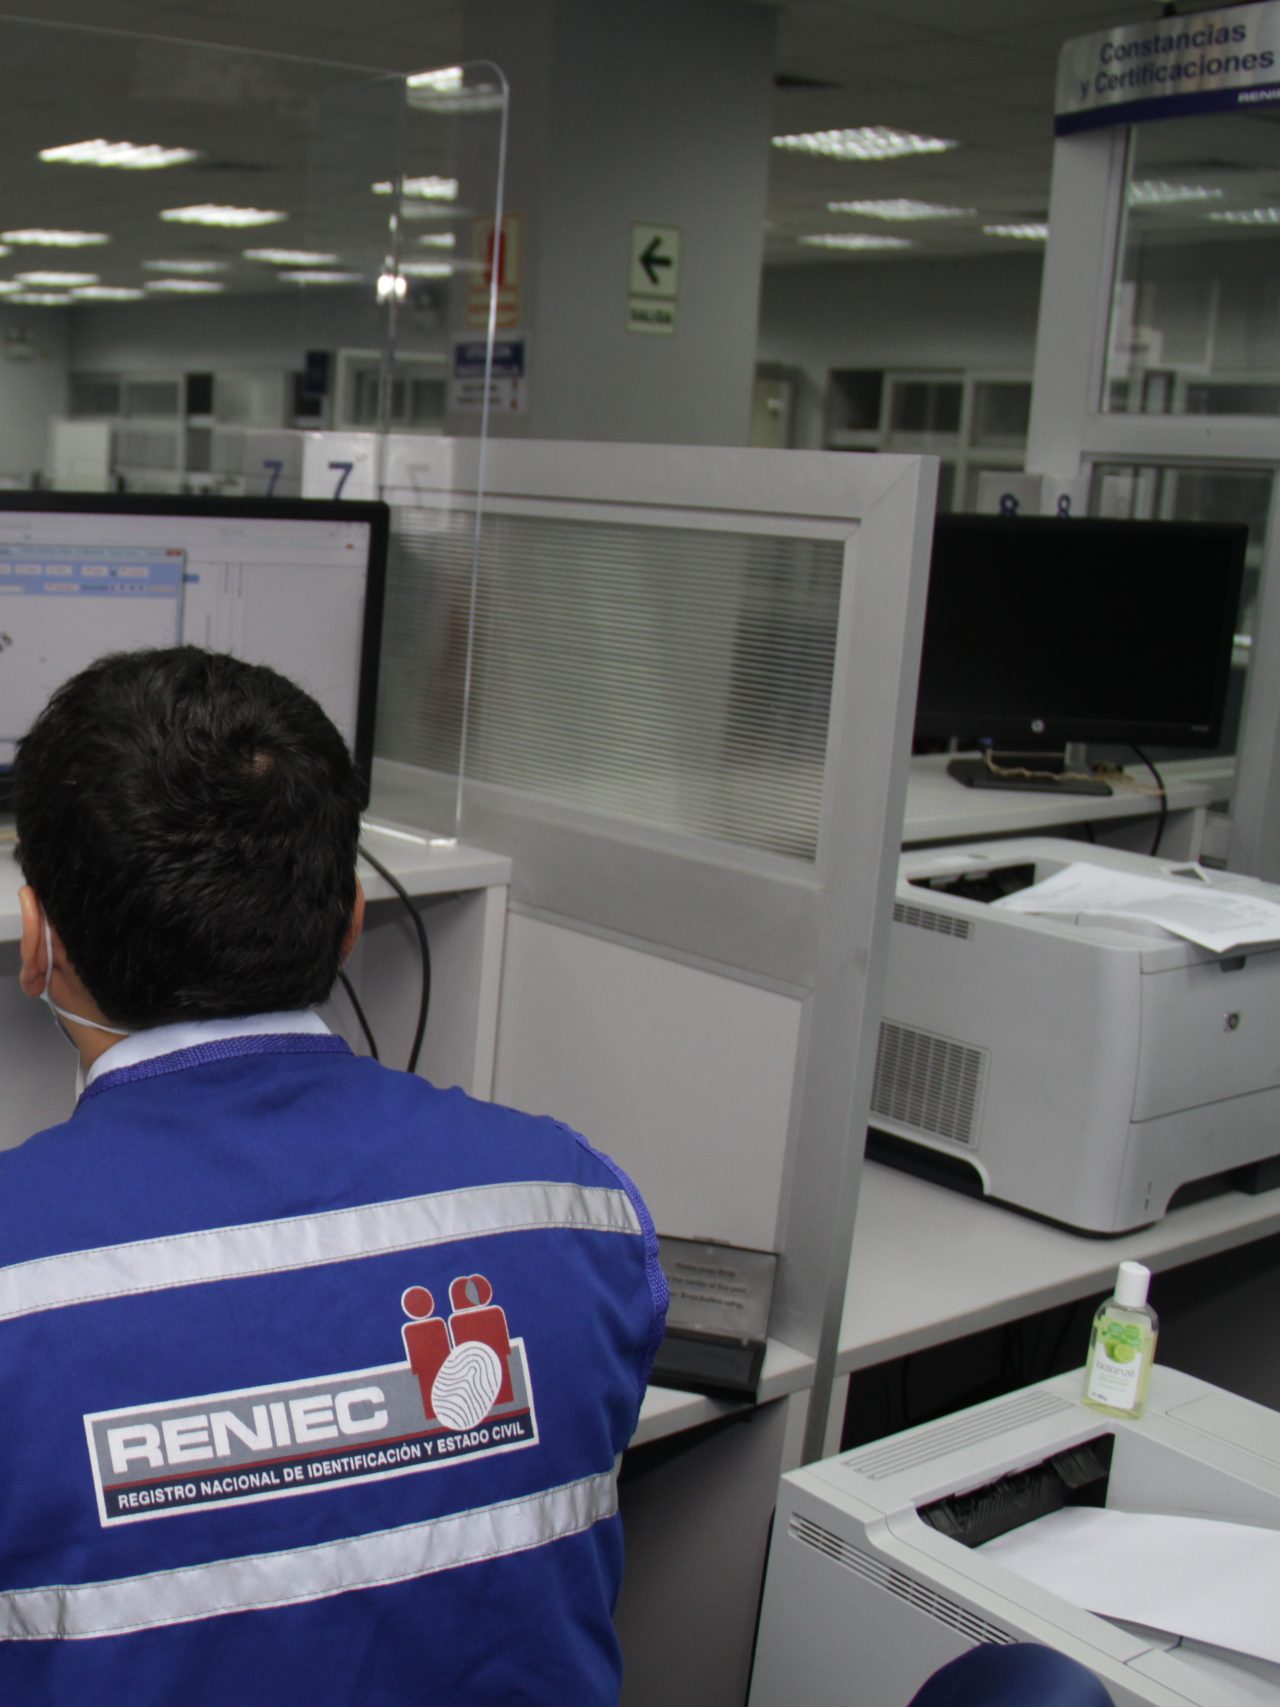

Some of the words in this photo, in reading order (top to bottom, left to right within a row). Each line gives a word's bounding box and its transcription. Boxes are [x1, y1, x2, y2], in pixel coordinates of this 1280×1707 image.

[1099, 23, 1246, 65] Constancias
[1080, 79, 1090, 98] y
[1094, 50, 1274, 94] Certificaciones
[263, 460, 283, 497] 7
[328, 461, 353, 500] 7
[107, 1385, 389, 1474] RENIEC
[118, 1483, 196, 1509] REGISTRO
[200, 1470, 280, 1497] NACIONAL
[283, 1466, 304, 1482] DE
[307, 1442, 421, 1479] IDENTIFICACIÓN
[424, 1442, 434, 1456] Y
[438, 1429, 490, 1454] ESTADO
[492, 1421, 525, 1441] CIVIL
